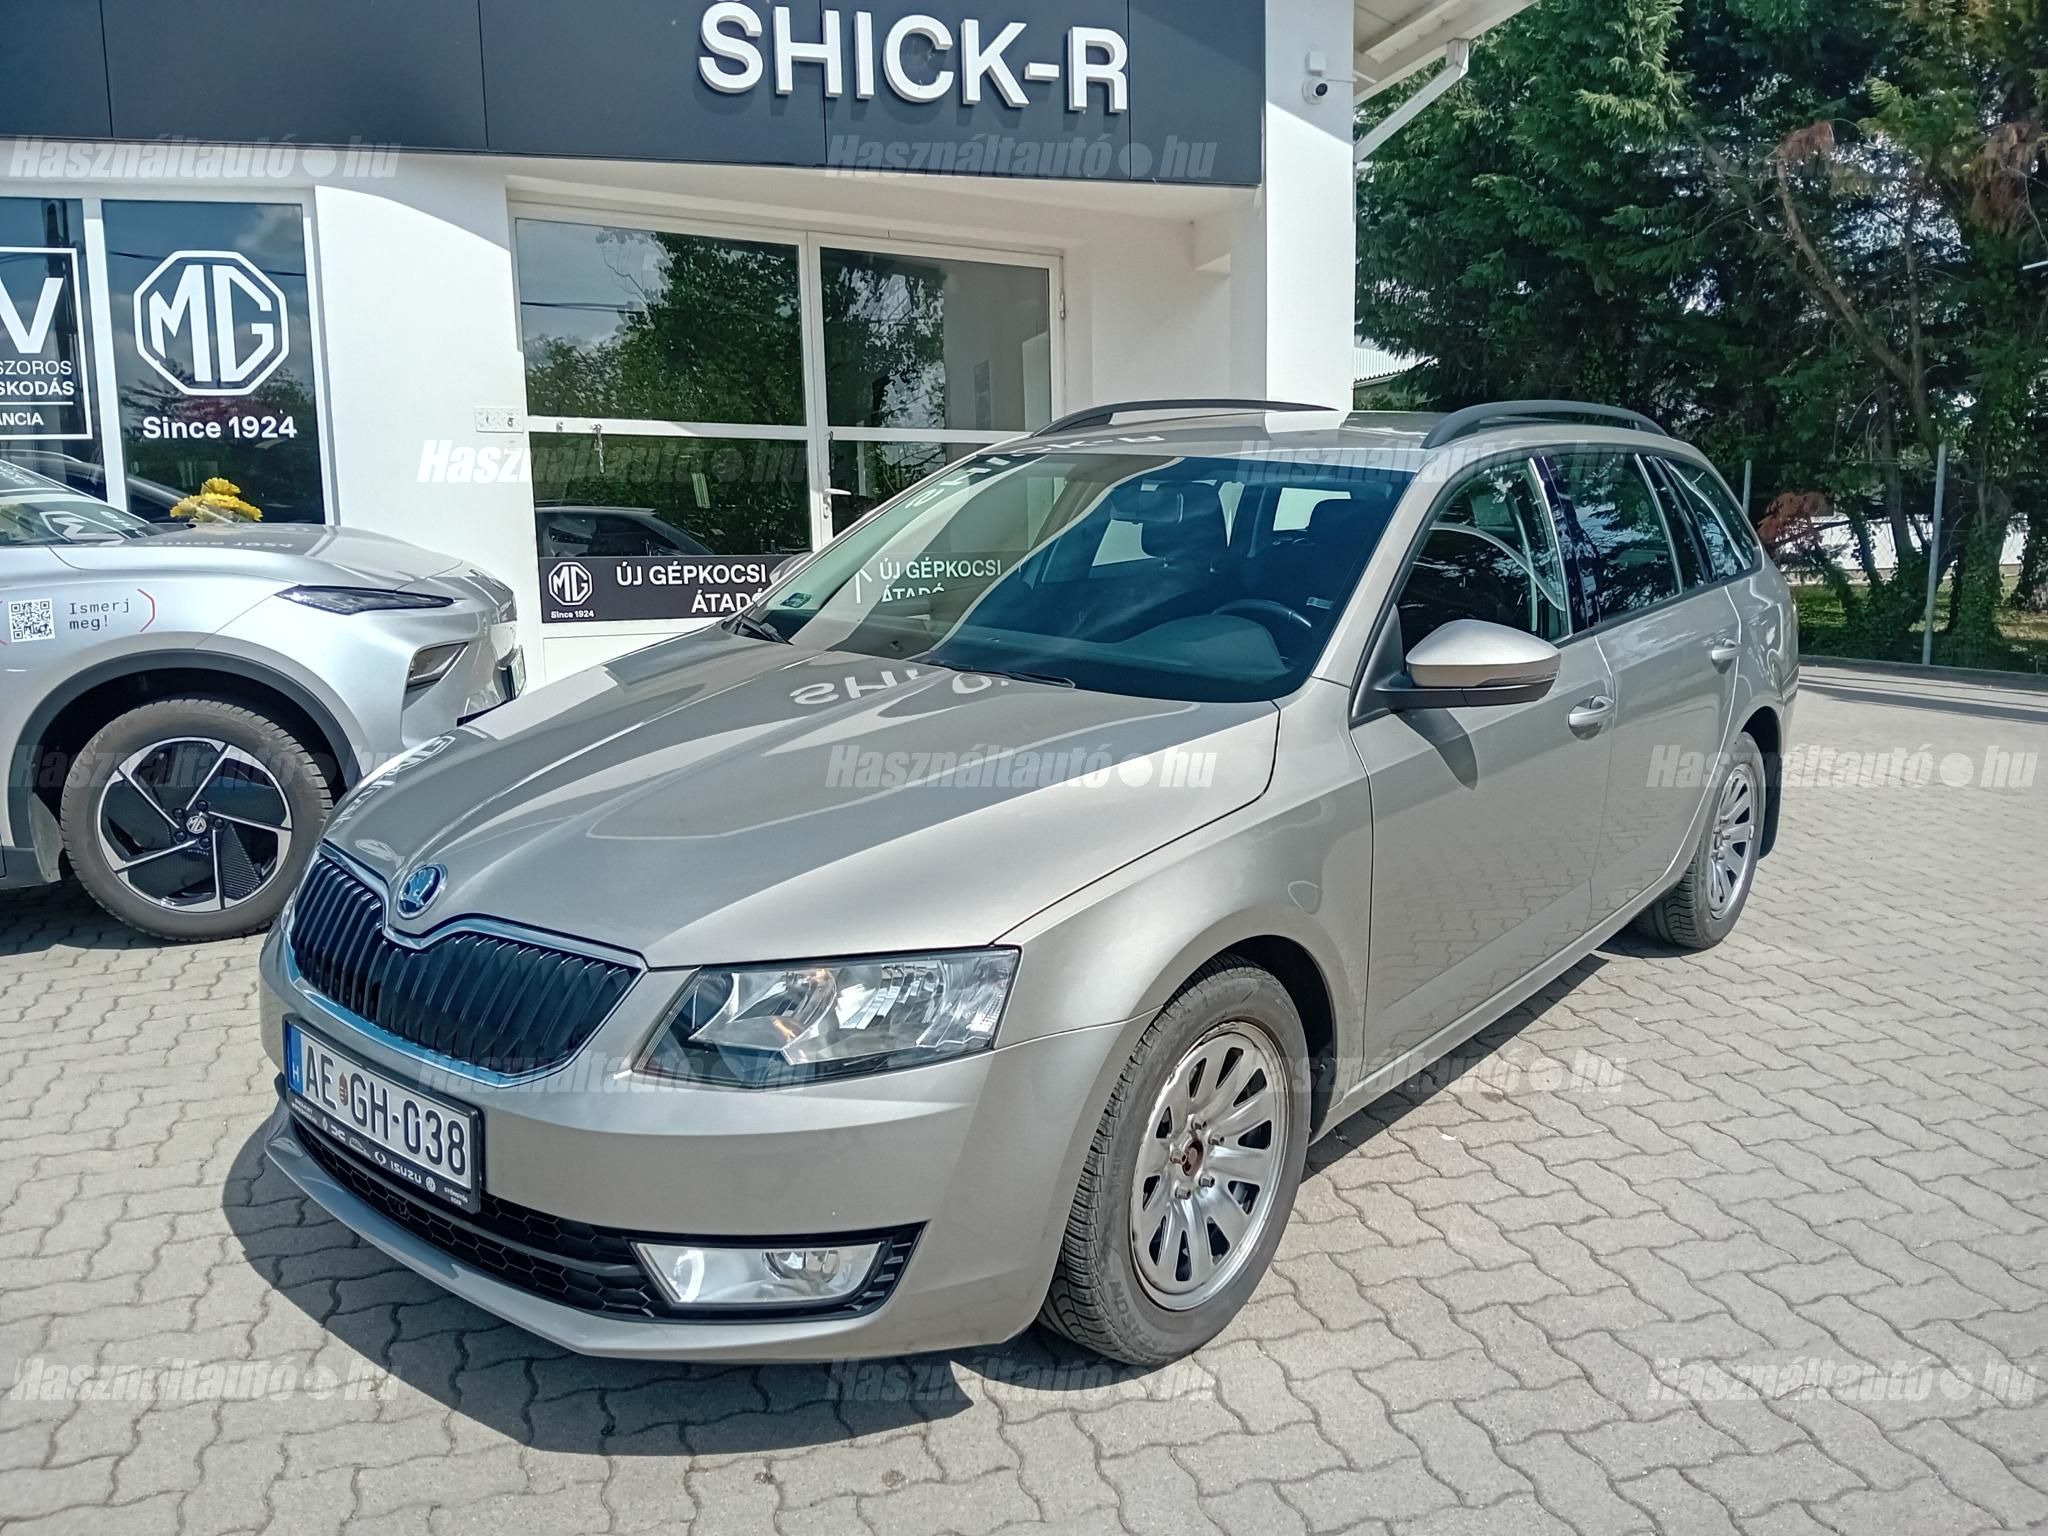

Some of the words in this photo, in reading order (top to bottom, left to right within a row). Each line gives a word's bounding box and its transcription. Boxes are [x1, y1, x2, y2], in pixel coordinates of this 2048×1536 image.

[699, 1, 1128, 113] SHICK-R
[149, 264, 275, 382] MG
[142, 416, 221, 439] Since
[228, 415, 297, 439] 1924
[551, 565, 590, 602] MG
[616, 561, 643, 586] ÚJ
[649, 560, 767, 586] GÉPKOCSI
[69, 598, 130, 615] Ismerj
[550, 610, 573, 620] Since
[575, 609, 594, 619] 1924
[69, 615, 109, 631] meg!
[292, 1062, 300, 1083] H
[305, 1044, 337, 1110] AE
